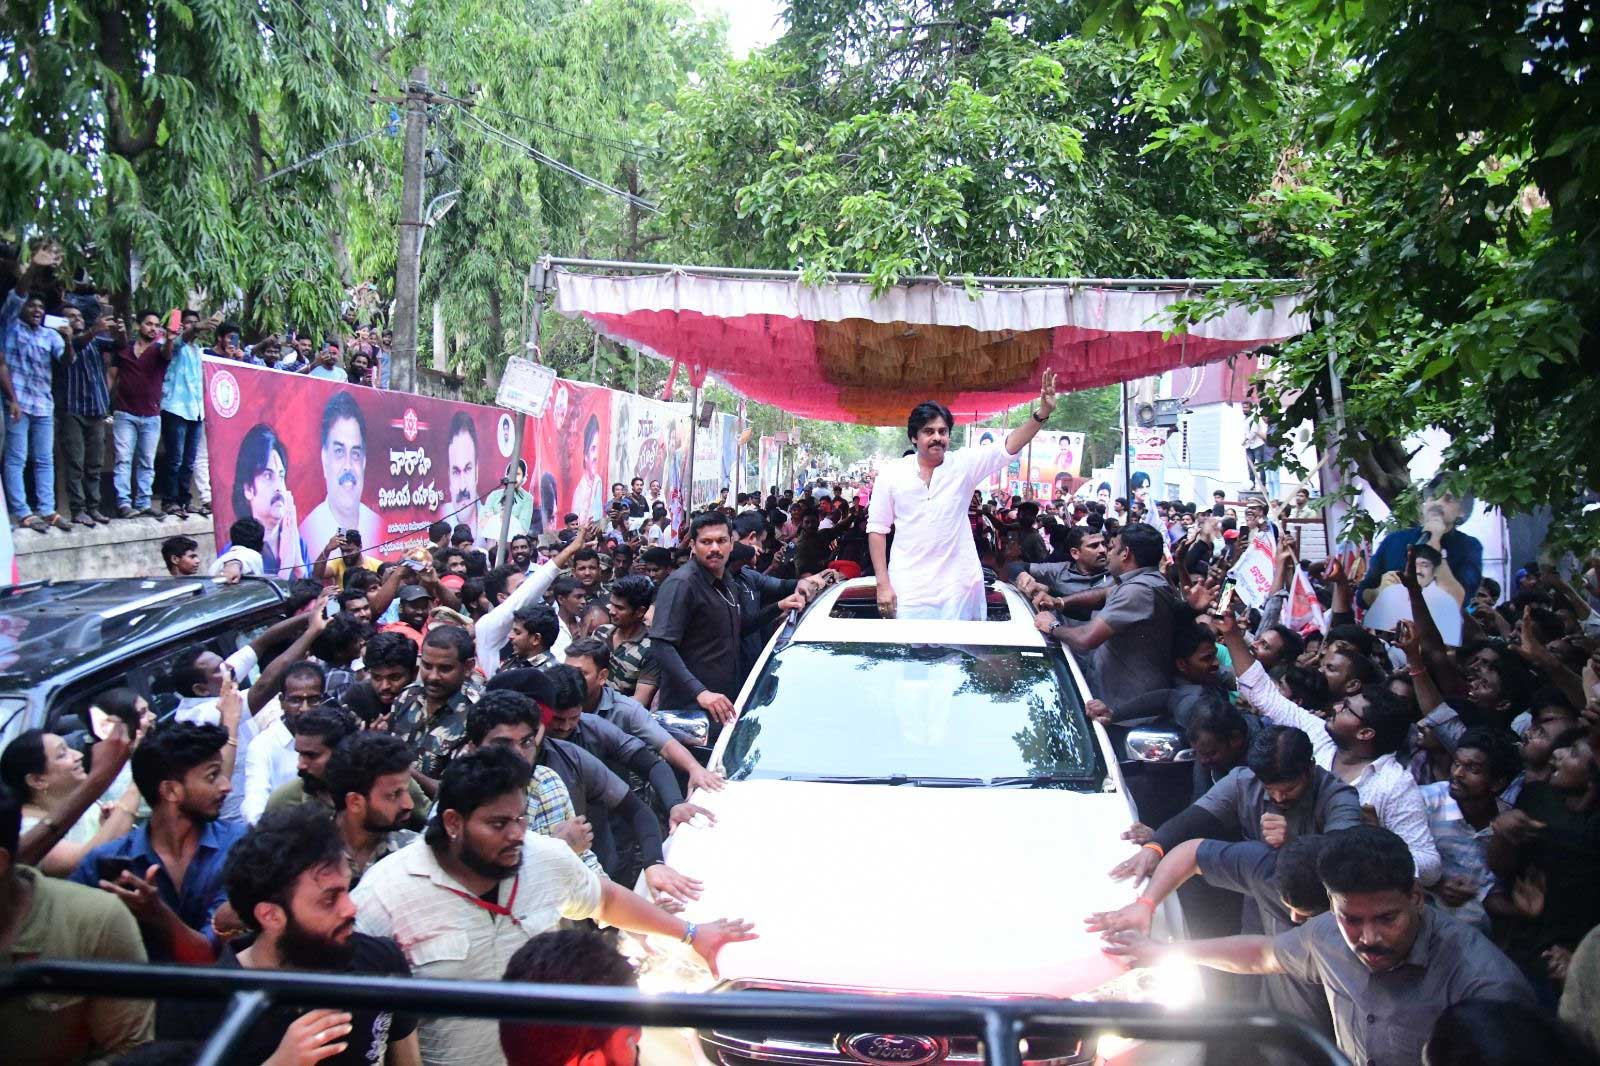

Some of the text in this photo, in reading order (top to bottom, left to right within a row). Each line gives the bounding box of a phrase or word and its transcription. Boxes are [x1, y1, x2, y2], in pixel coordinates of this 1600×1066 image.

[389, 447, 432, 476] వారాహి
[379, 482, 410, 507] విజయ
[868, 1037, 915, 1059] Ford
